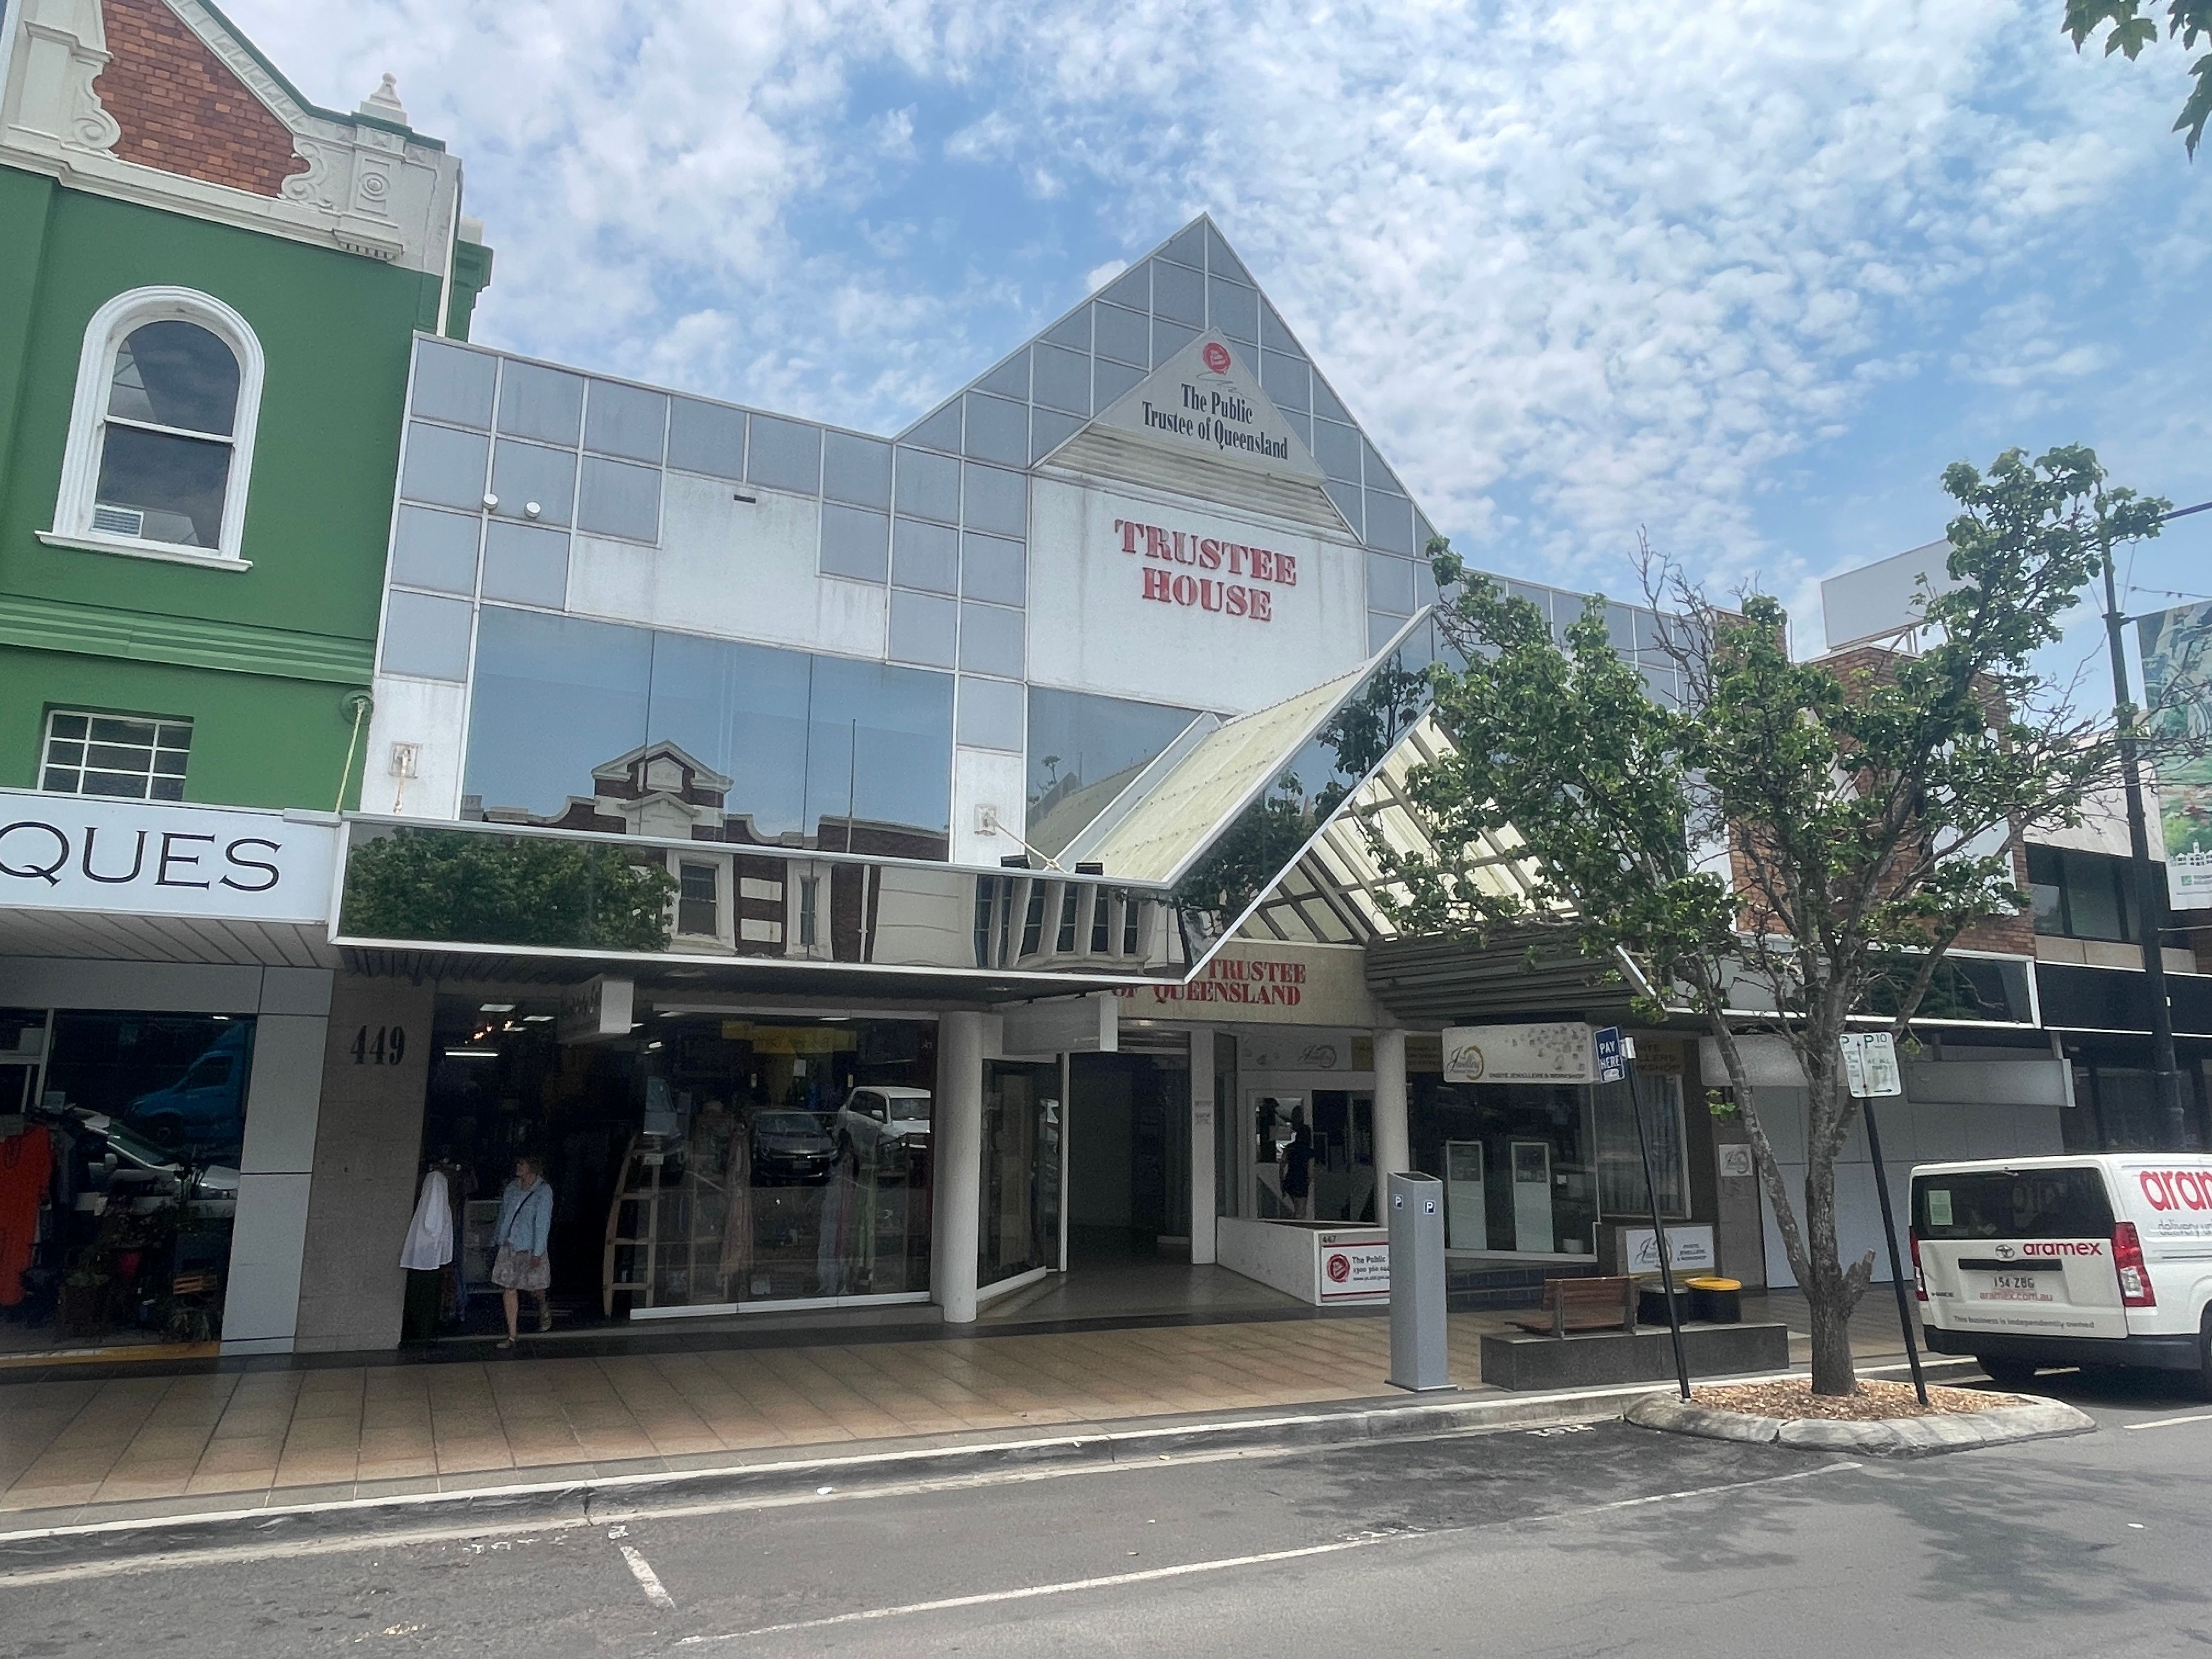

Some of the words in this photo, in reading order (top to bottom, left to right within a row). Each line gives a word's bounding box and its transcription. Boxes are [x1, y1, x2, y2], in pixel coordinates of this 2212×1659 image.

[1181, 383, 1207, 412] The
[1211, 390, 1253, 425] Public
[1142, 400, 1194, 437] Trustee
[1198, 416, 1211, 442] of
[1214, 419, 1289, 461] Queensland
[1115, 519, 1297, 586] TRUSTEE
[1142, 567, 1272, 622] HOUSE
[0, 821, 282, 892] QUES
[1209, 958, 1306, 984] TRUSTEE
[1153, 981, 1301, 1006] QUEENSLAND
[350, 1025, 405, 1066] 449
[1599, 1040, 1616, 1055] PAY
[1863, 1035, 1874, 1049] P
[1875, 1034, 1887, 1043] 10
[1600, 1054, 1622, 1070] HERE
[1426, 1201, 1434, 1213] P
[2022, 1242, 2103, 1256] aramex
[1352, 1256, 1365, 1264] The
[1994, 1276, 2010, 1288] 154
[1979, 1292, 2053, 1301] aramex.com.au
